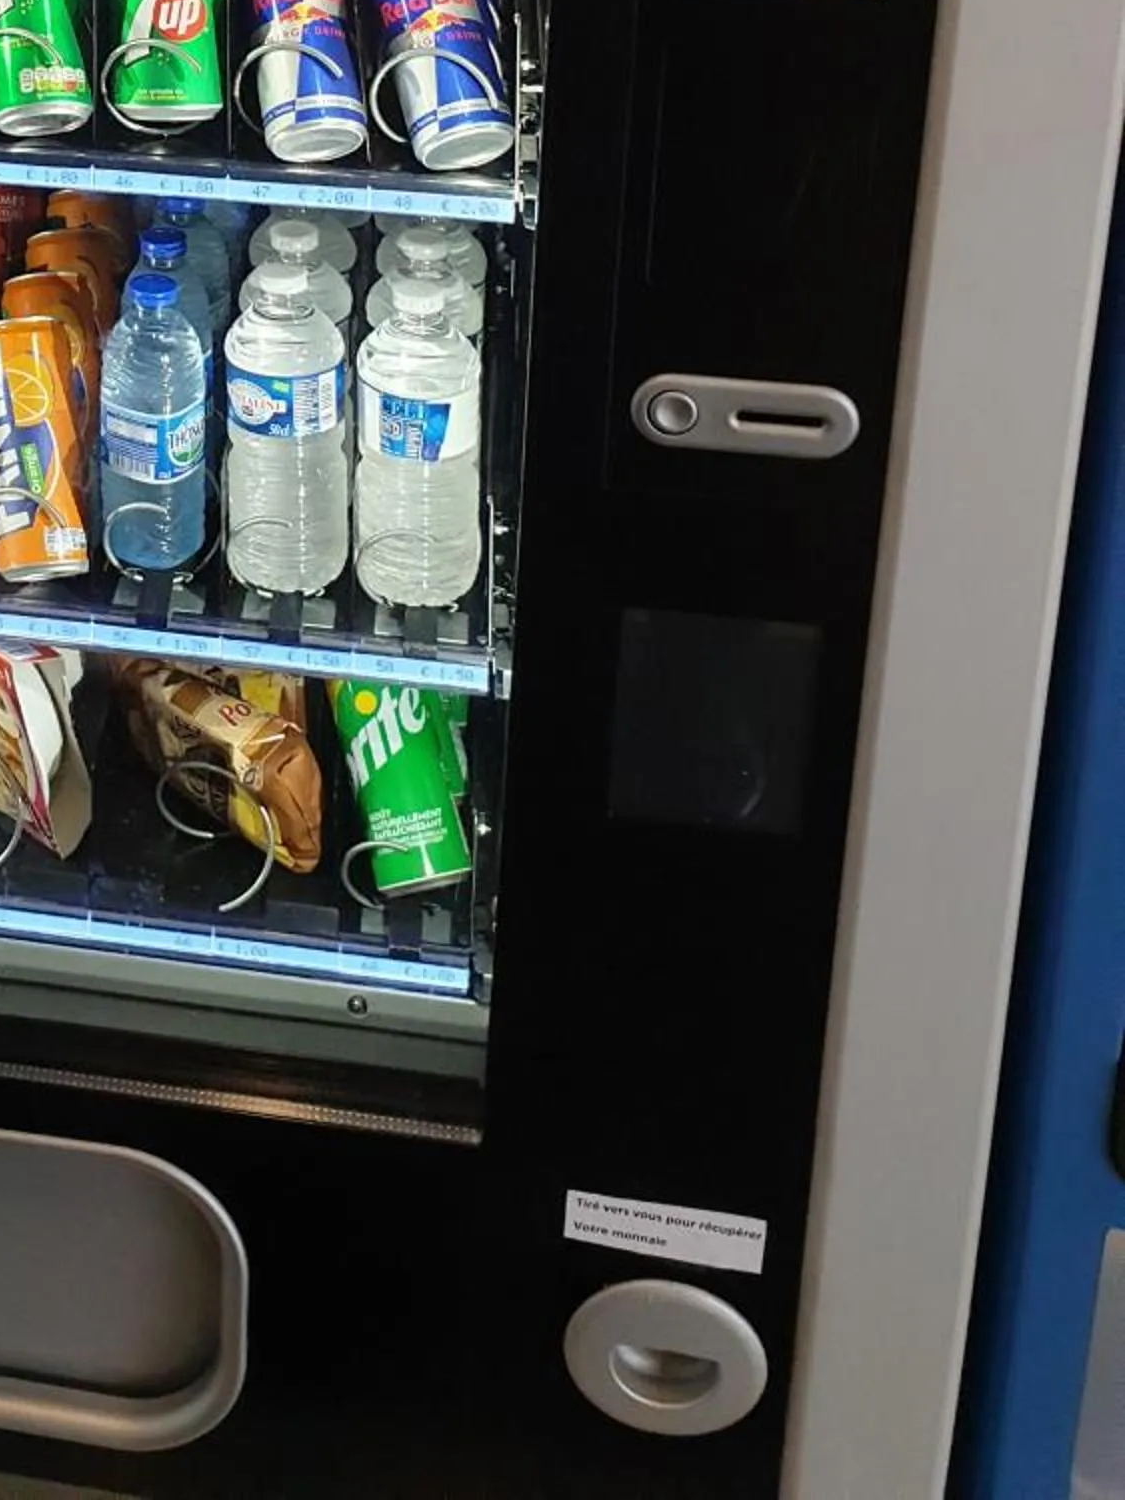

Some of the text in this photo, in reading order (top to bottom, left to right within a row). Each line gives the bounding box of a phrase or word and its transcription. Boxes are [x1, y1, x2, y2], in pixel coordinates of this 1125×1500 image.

[252, 184, 355, 206] 47 2.00
[573, 1219, 668, 1247] Votre monnaie
[576, 1197, 763, 1241] Tiré vers vous pour récupérer
